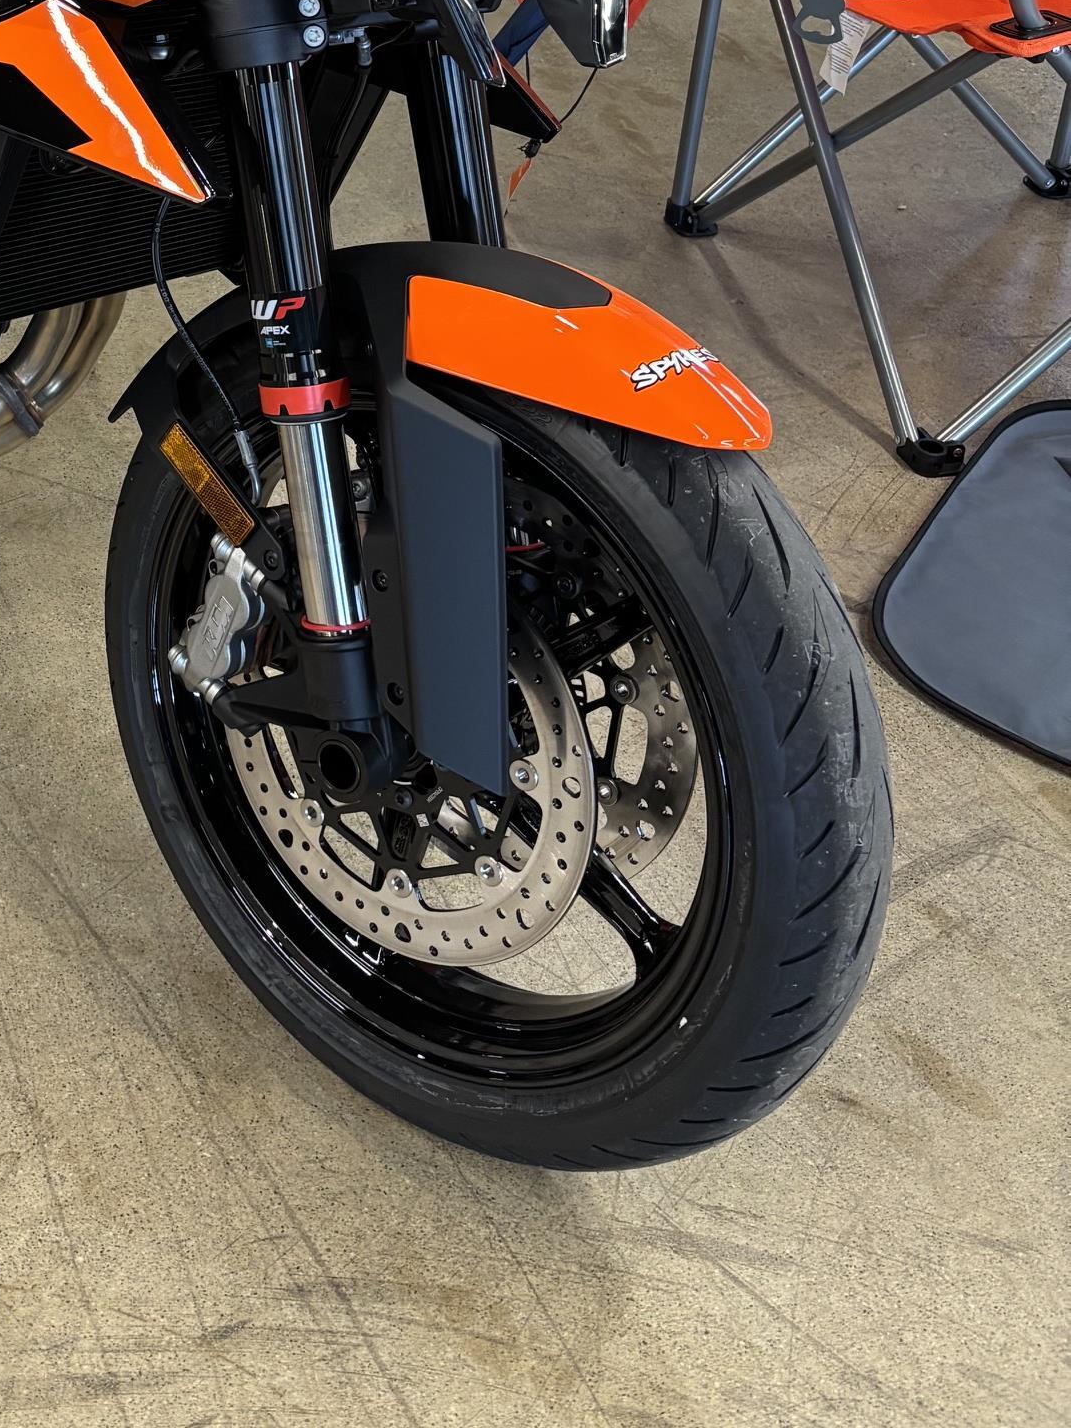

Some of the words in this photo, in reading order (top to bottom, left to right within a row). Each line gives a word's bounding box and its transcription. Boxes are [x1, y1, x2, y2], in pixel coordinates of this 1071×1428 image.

[250, 296, 307, 321] WP
[260, 324, 291, 336] APEX
[630, 346, 721, 392] SPYKES
[201, 595, 235, 662] KTM
